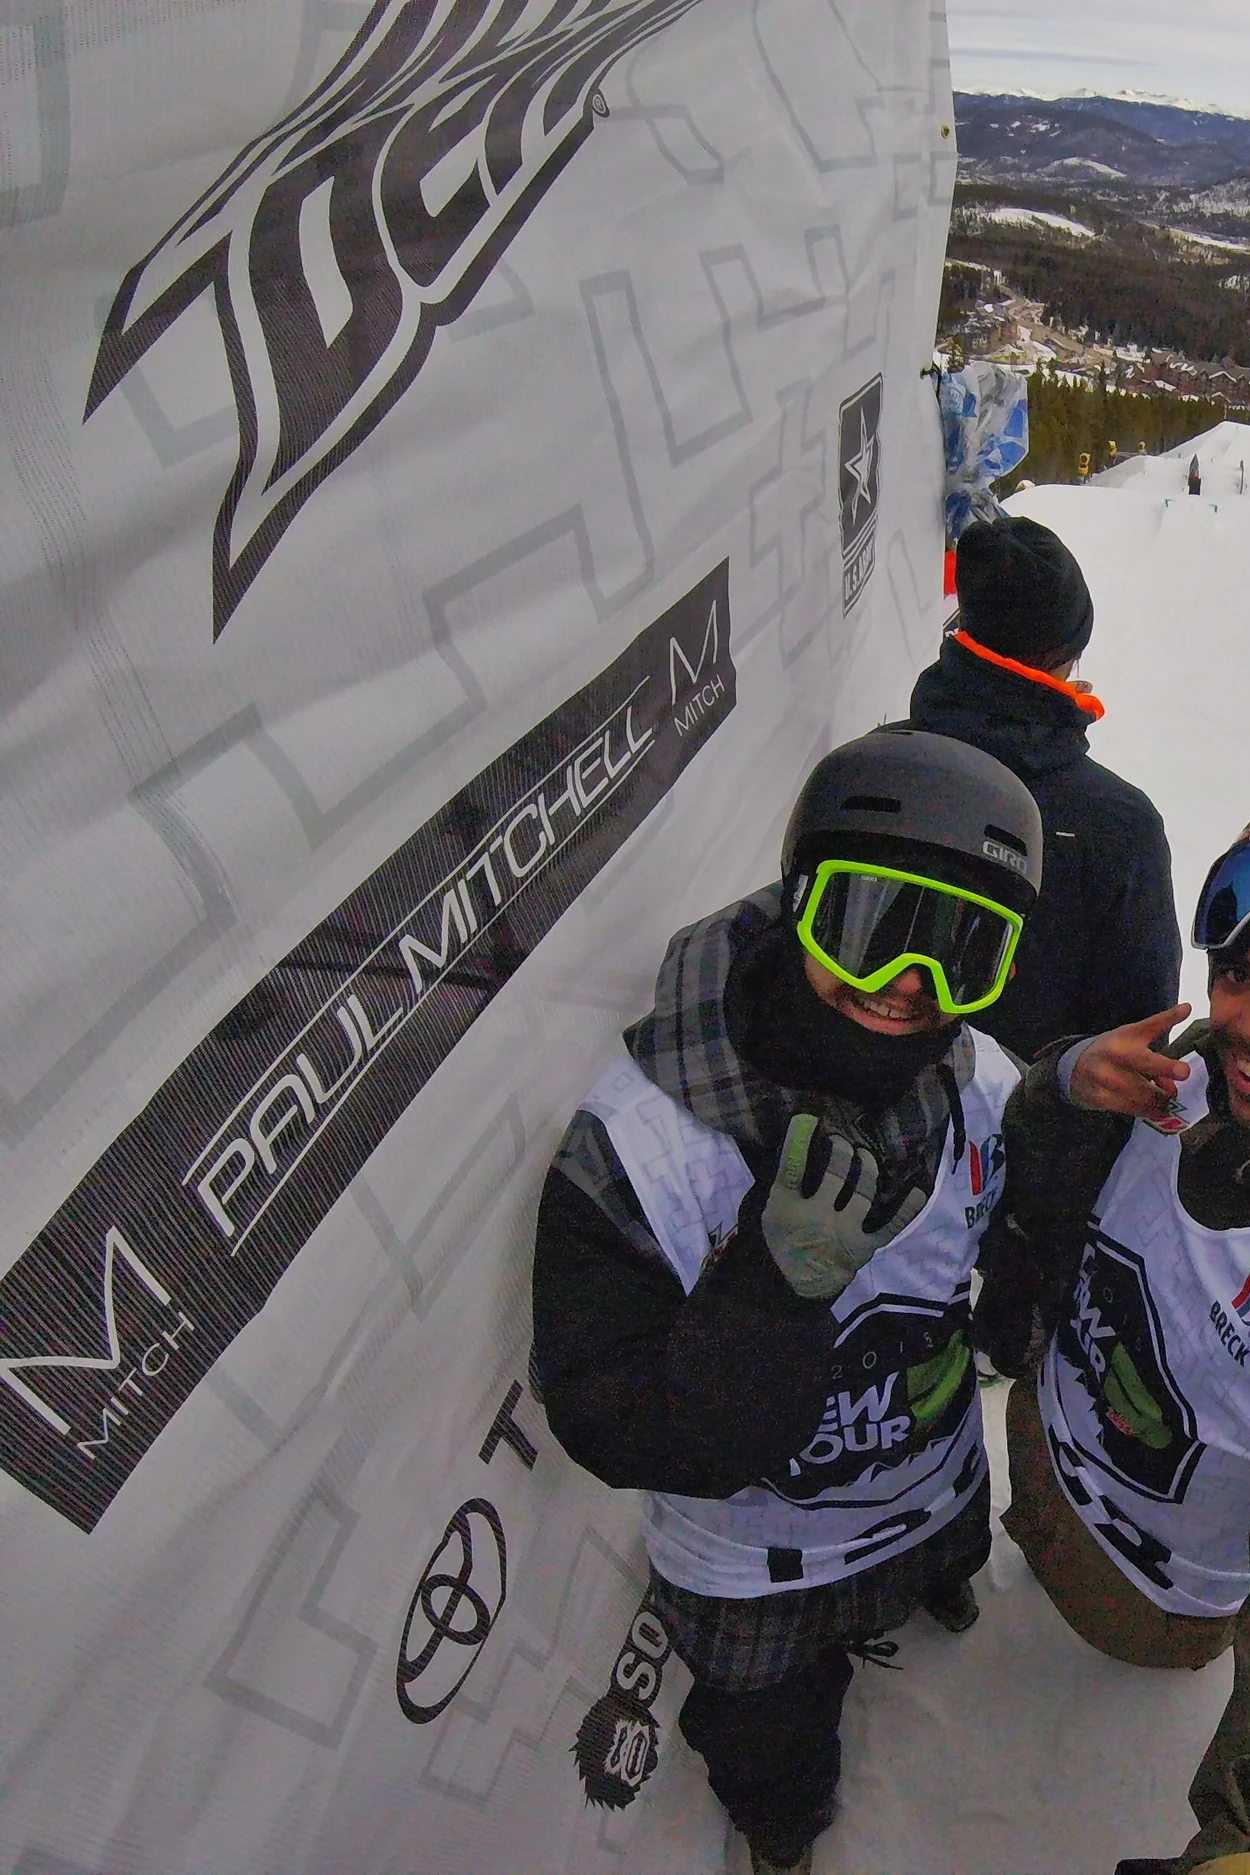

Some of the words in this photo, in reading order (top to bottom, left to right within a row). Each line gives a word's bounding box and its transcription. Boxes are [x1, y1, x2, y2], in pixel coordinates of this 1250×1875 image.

[673, 674, 727, 737] MITCH
[982, 841, 1029, 874] GIRO
[196, 993, 403, 1239] PAUL
[402, 705, 655, 994] MITCHELL
[1208, 1300, 1250, 1368] BRECK
[76, 1305, 194, 1460] MITCH
[816, 1371, 900, 1434] EW
[789, 1415, 912, 1477] OUR
